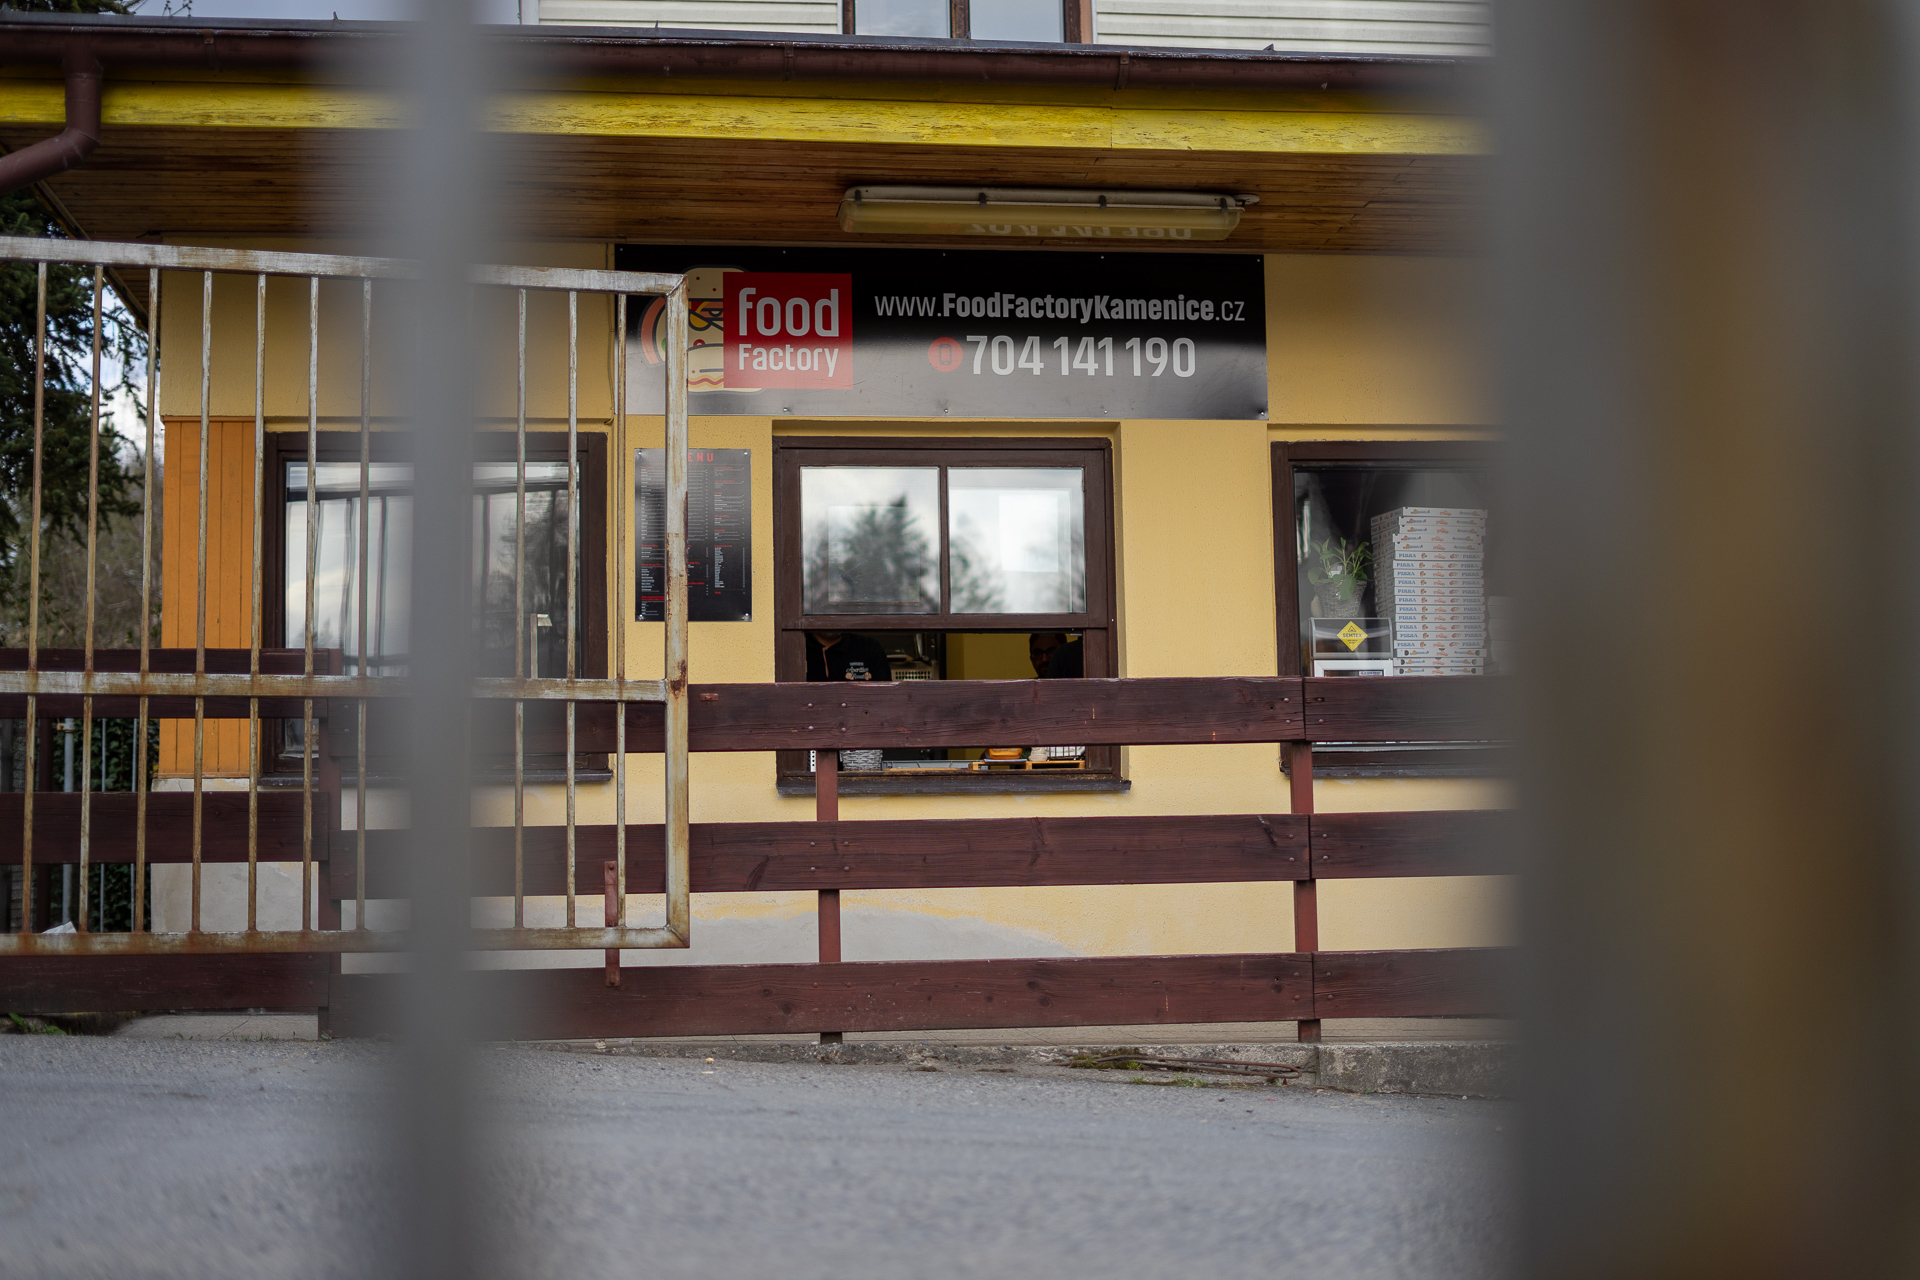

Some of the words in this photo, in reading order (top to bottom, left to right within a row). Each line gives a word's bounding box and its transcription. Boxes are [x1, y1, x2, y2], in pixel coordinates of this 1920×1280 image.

[739, 287, 839, 337] food
[874, 292, 1245, 324] www.FoodFactoryKamenice.cz
[739, 344, 839, 378] Factory
[966, 335, 1044, 376] 704
[1053, 336, 1114, 376] 141
[1125, 338, 1196, 378] 190
[688, 452, 714, 462] ENU
